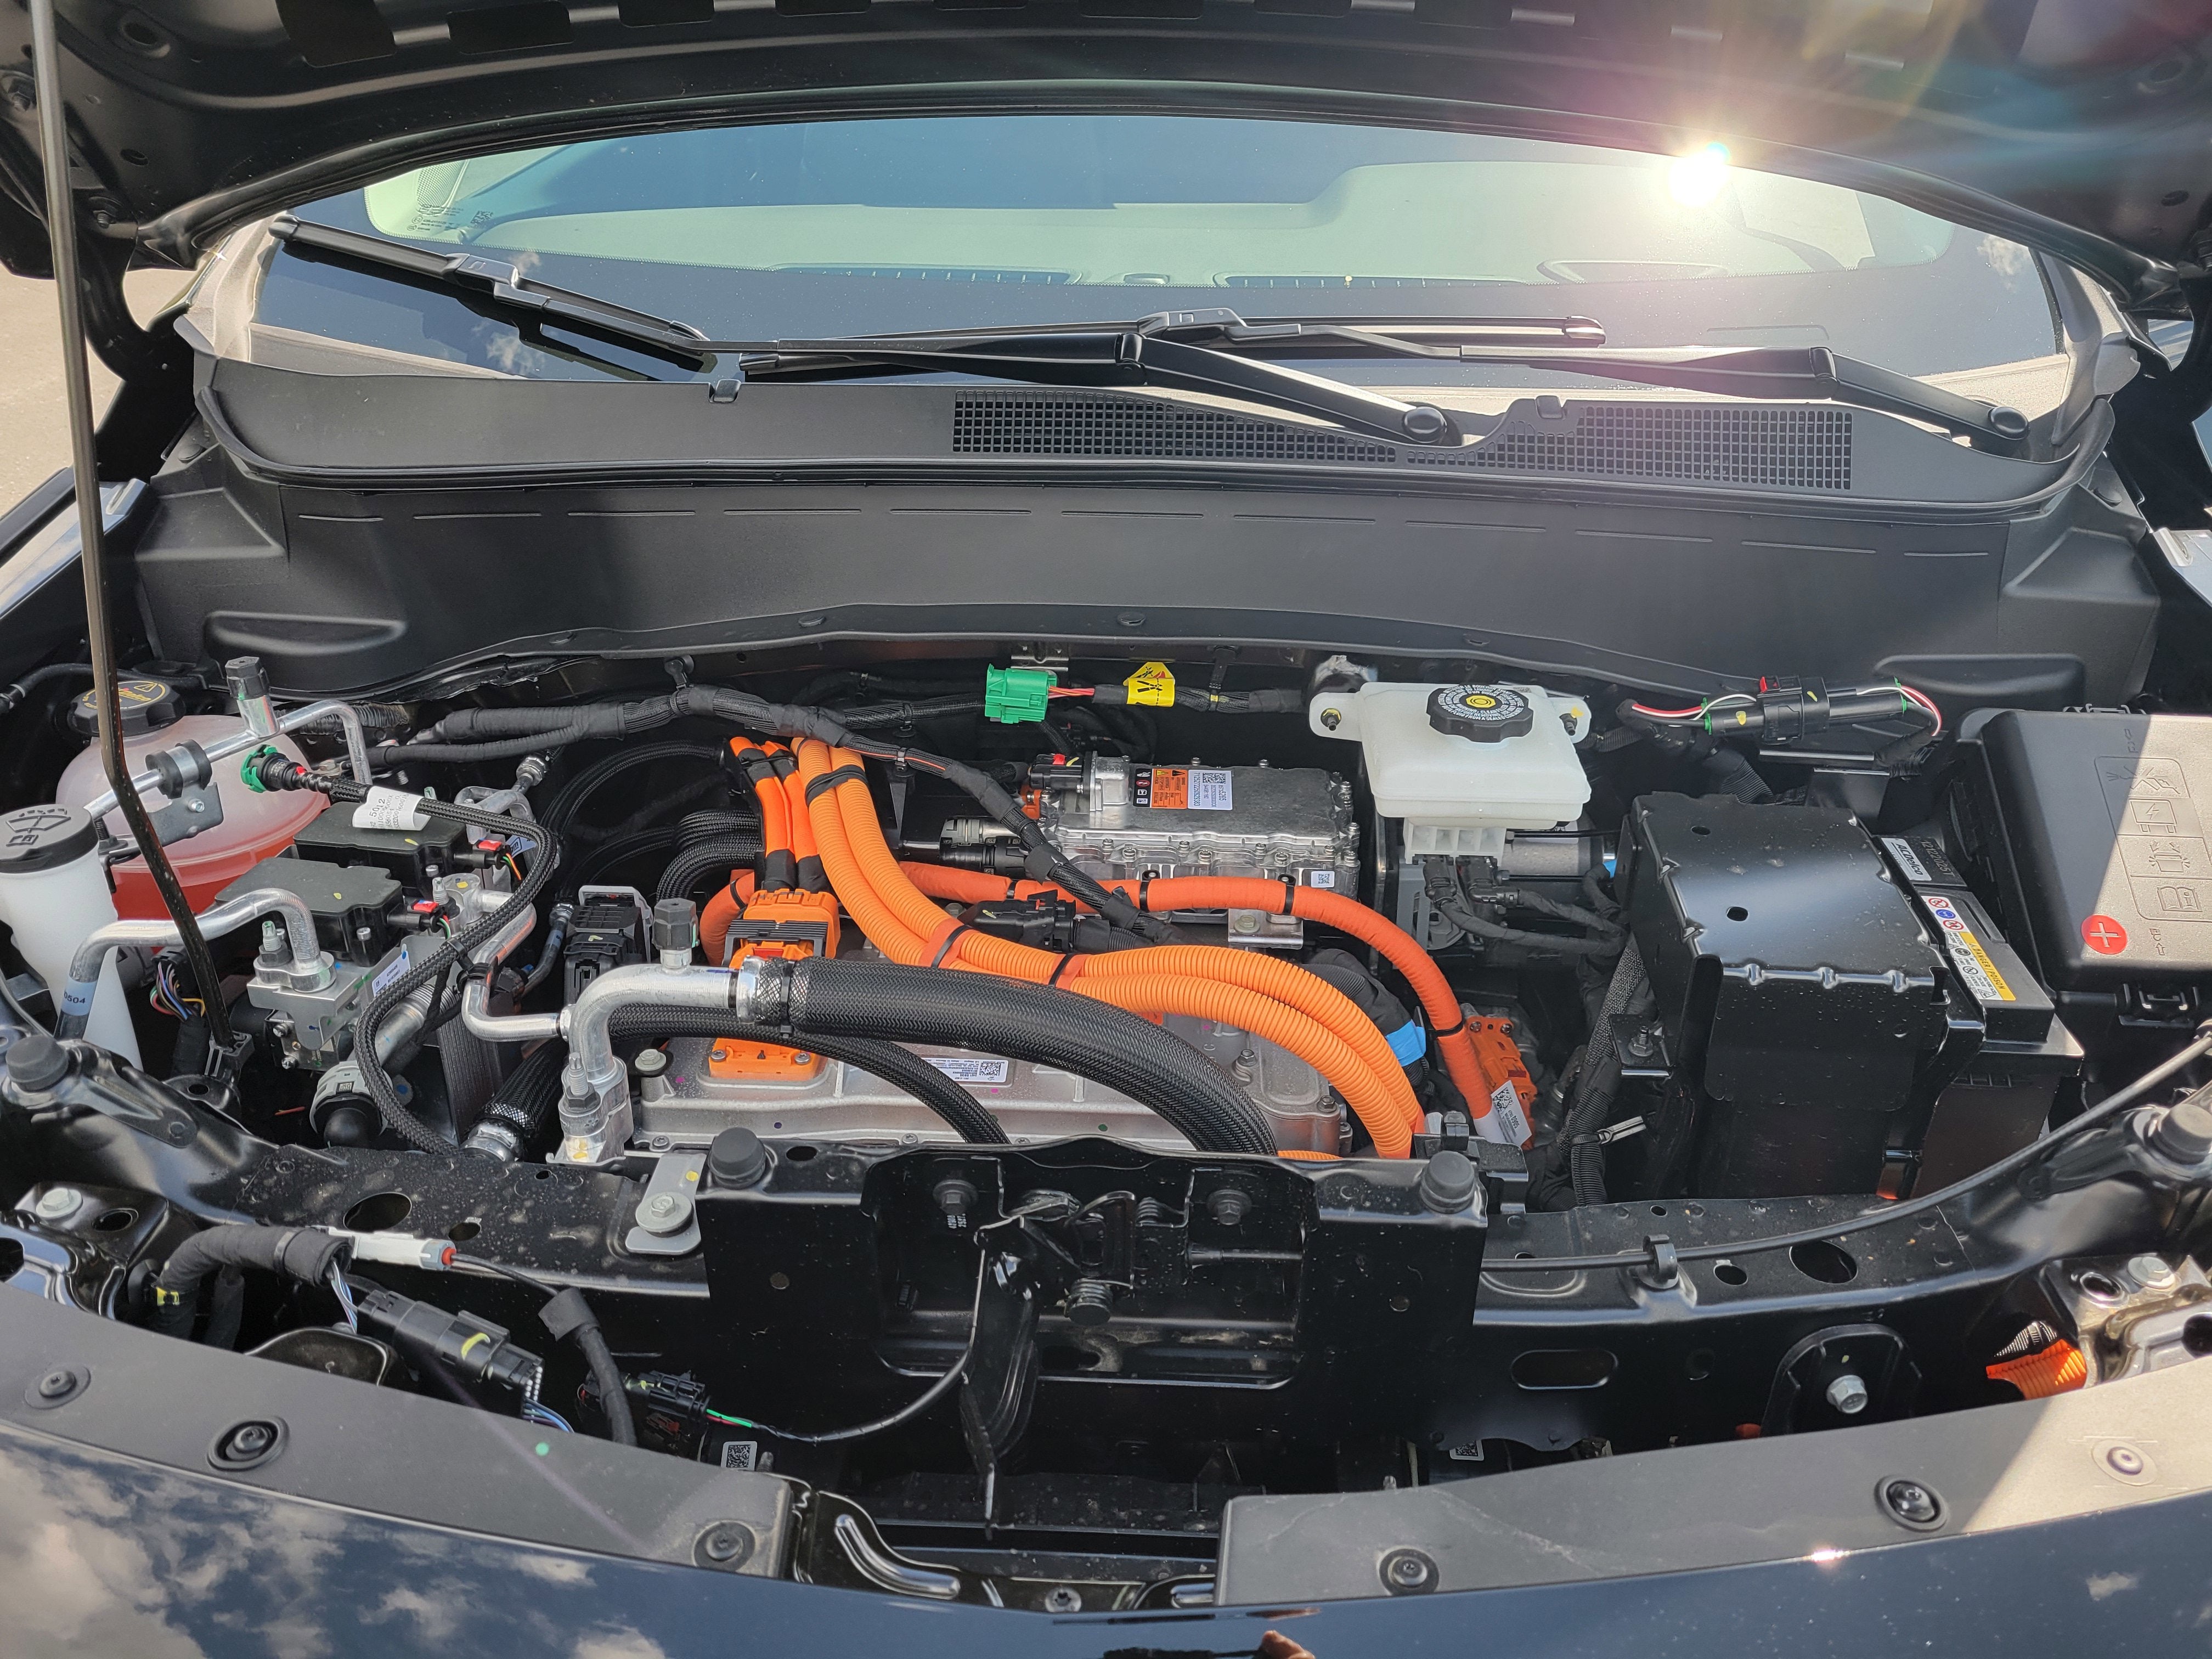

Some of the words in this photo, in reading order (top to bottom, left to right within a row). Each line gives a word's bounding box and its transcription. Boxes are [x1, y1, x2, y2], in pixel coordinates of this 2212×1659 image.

[369, 799, 386, 817] 5012
[1897, 844, 1923, 876] ACDelco
[1921, 840, 1955, 877] 12122025T
[1974, 949, 2005, 989] DANGER/POISON
